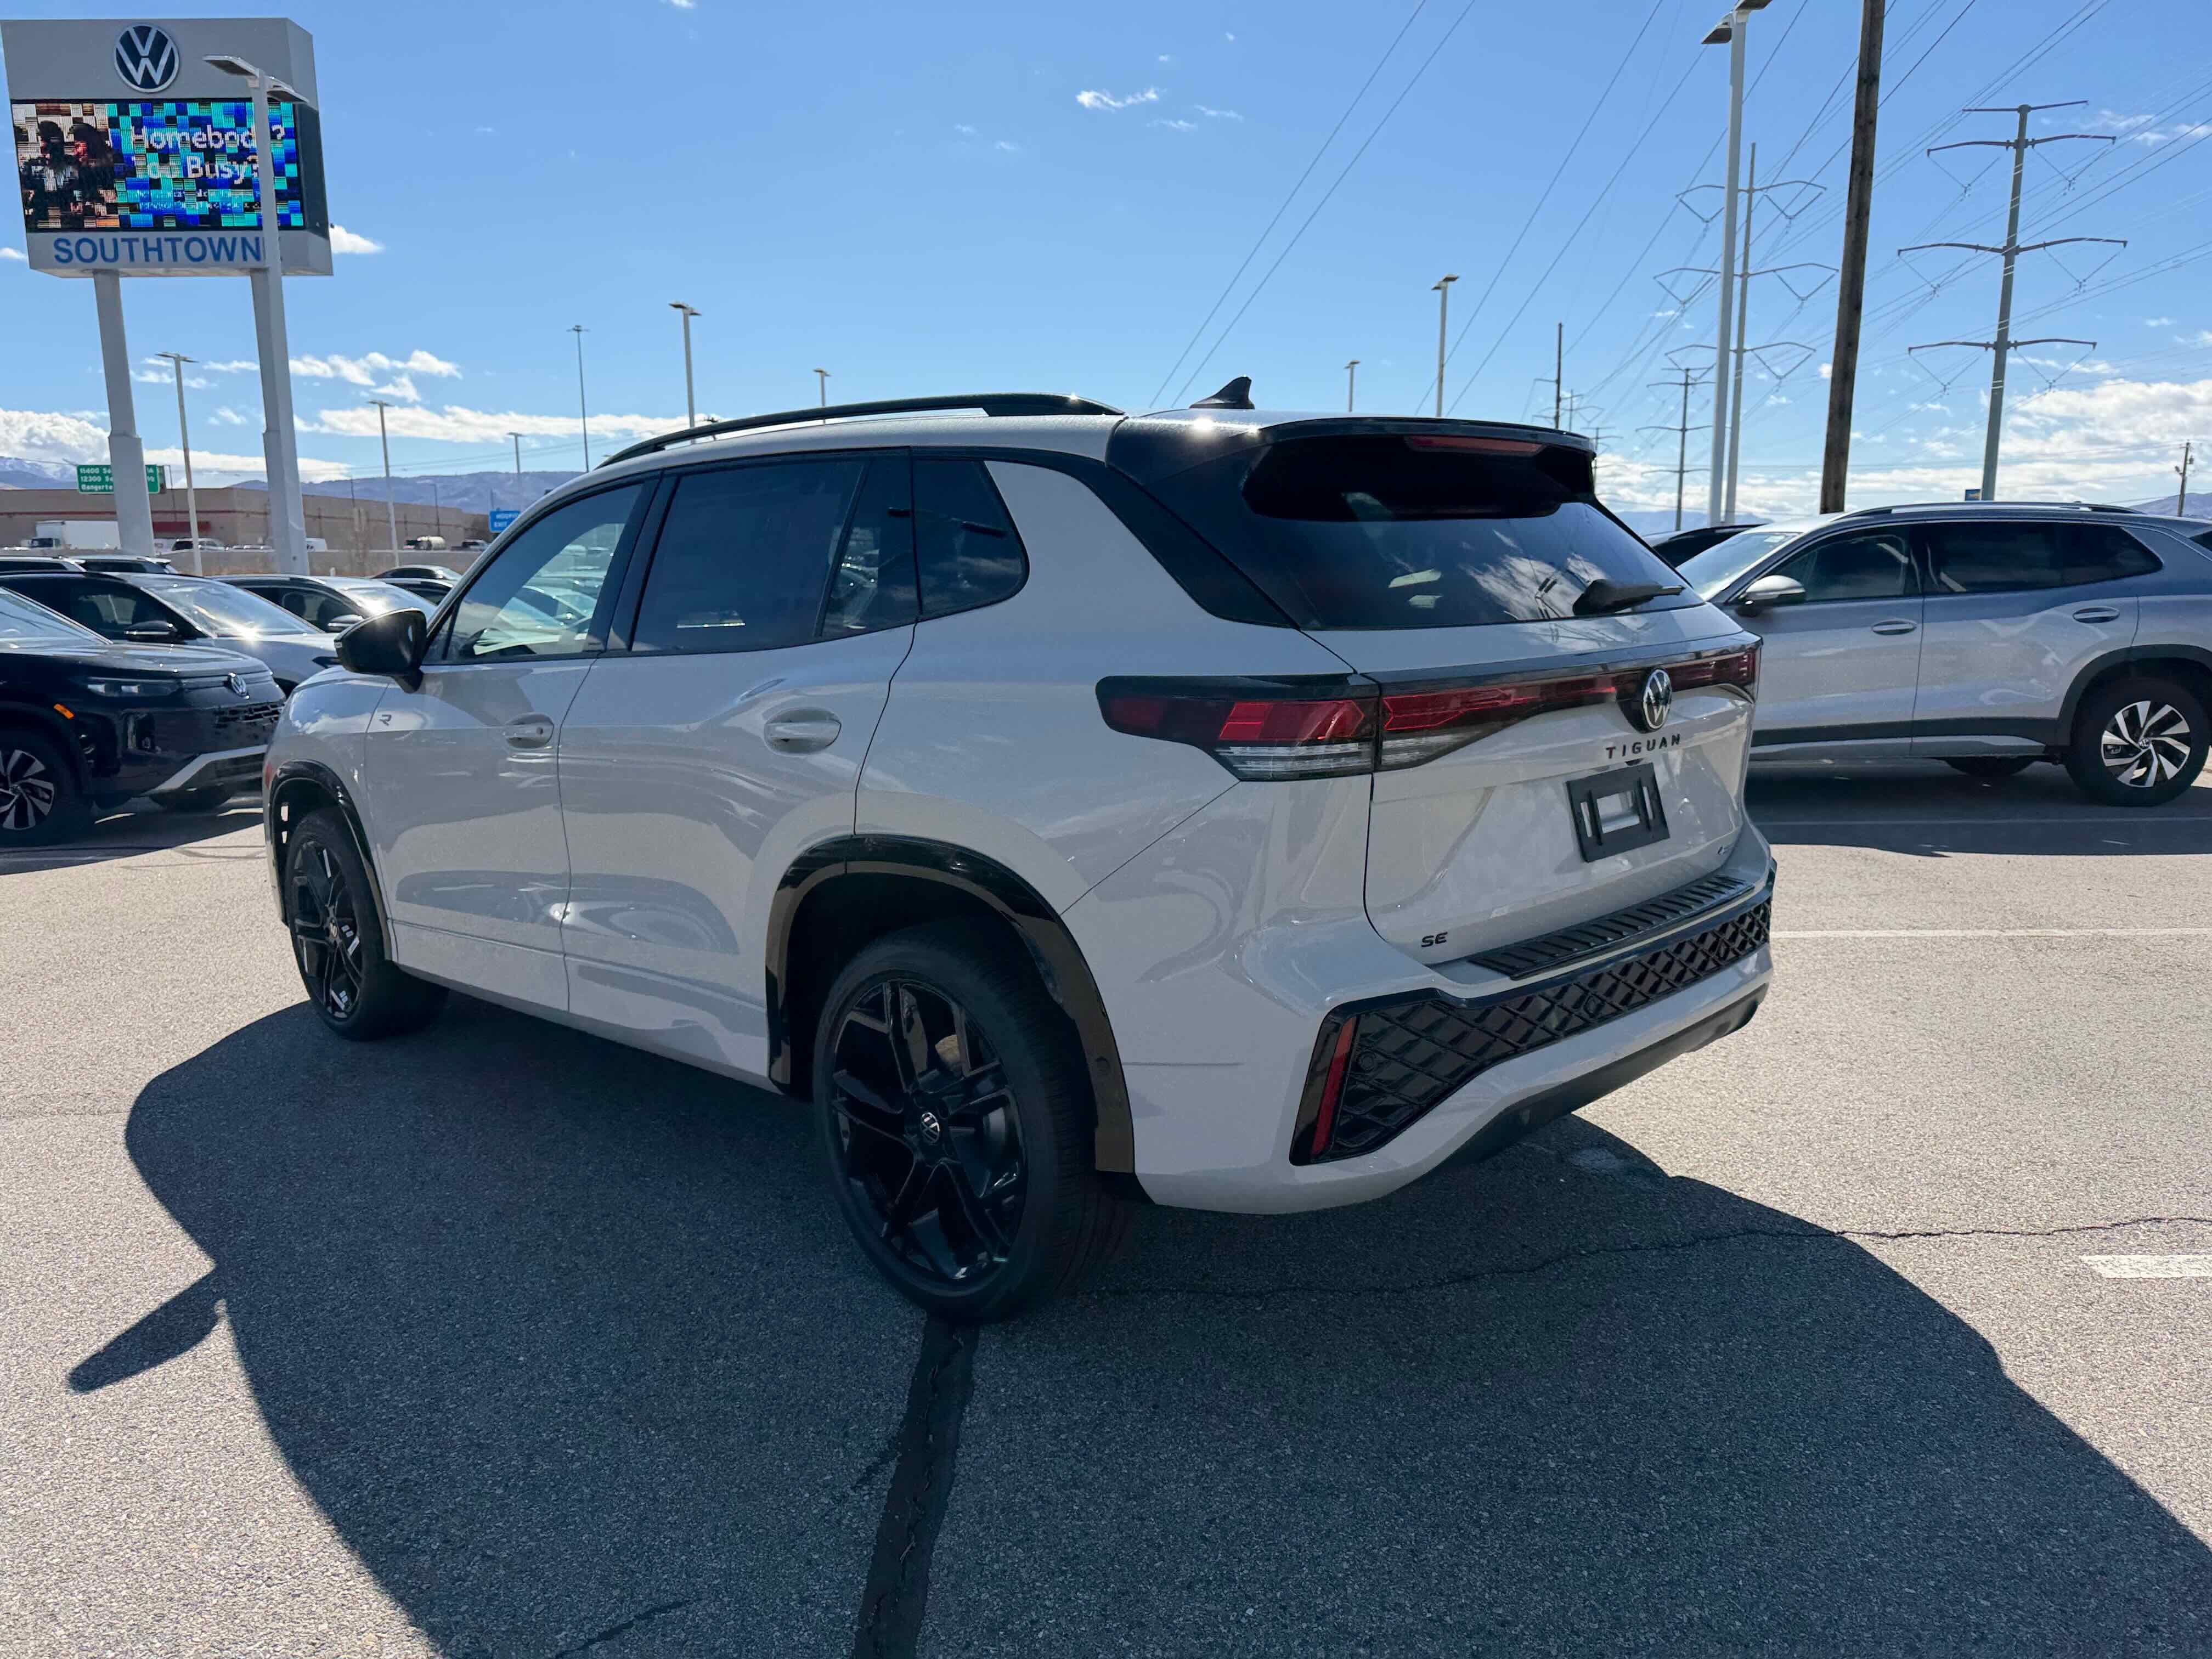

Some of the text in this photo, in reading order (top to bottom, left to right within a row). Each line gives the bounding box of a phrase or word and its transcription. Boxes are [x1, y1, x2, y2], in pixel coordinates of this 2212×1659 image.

[132, 125, 285, 149] Homebod?
[53, 236, 282, 264] SOUTHTOWN
[379, 714, 392, 726] R
[1606, 733, 1680, 759] TIGUAN
[1421, 932, 1448, 947] SE
